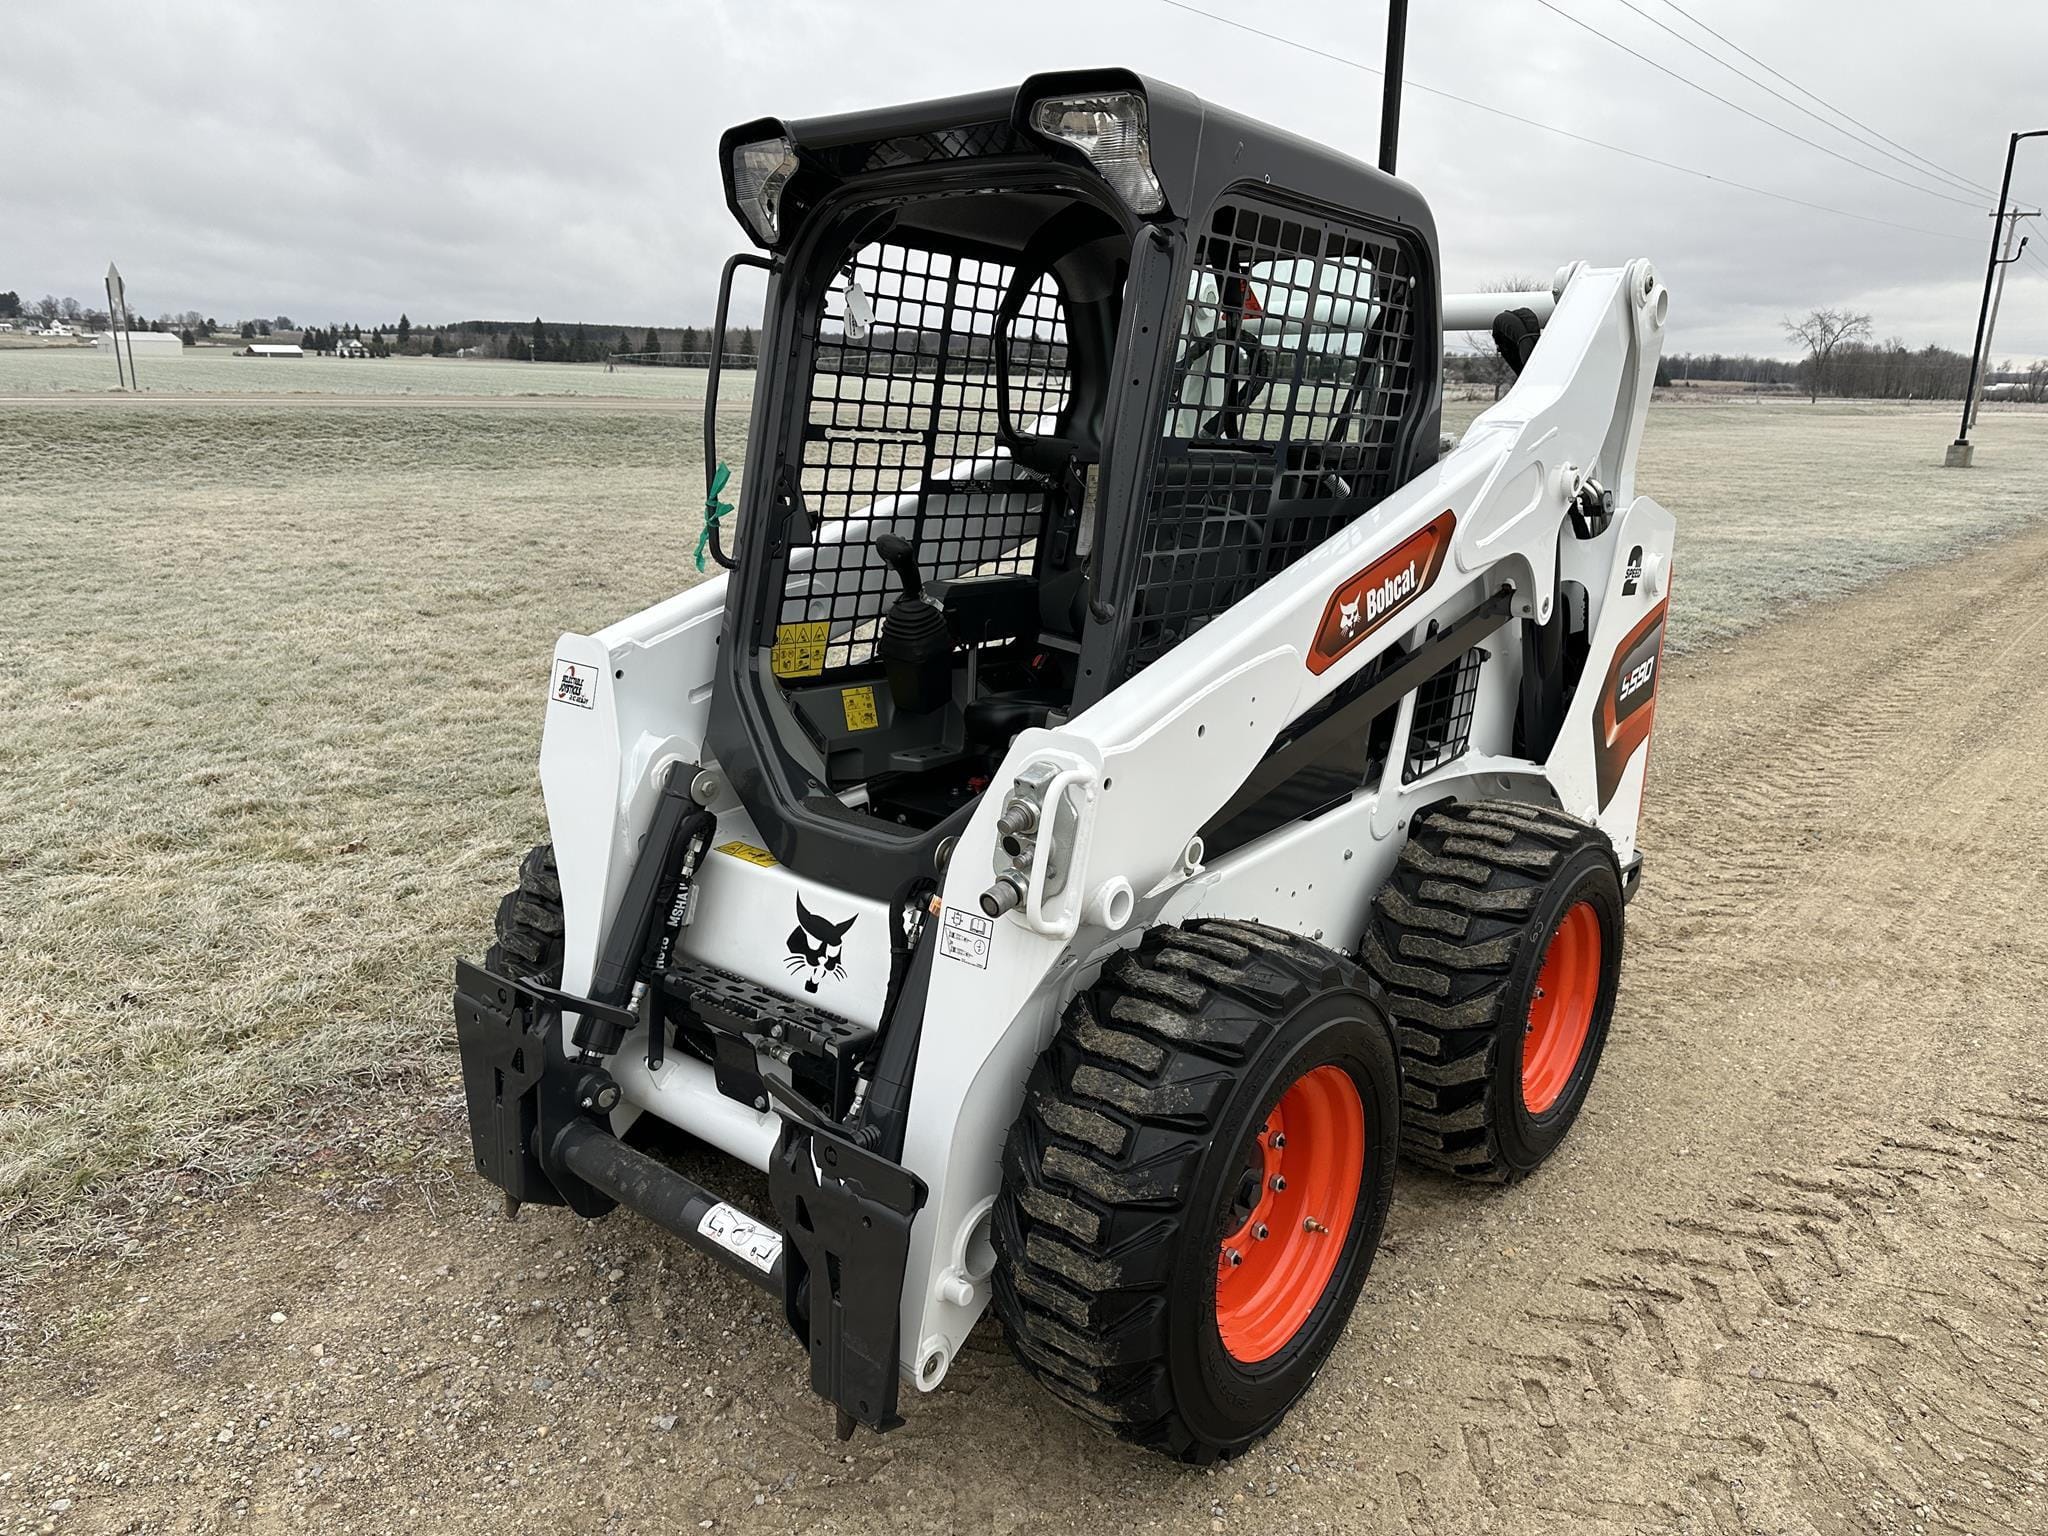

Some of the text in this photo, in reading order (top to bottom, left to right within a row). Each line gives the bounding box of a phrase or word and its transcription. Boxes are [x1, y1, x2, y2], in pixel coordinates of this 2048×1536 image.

[1366, 559, 1416, 622] Bobcat
[1625, 568, 1642, 579] SPEED
[1620, 655, 1655, 701] S590
[667, 892, 689, 927] MSHA
